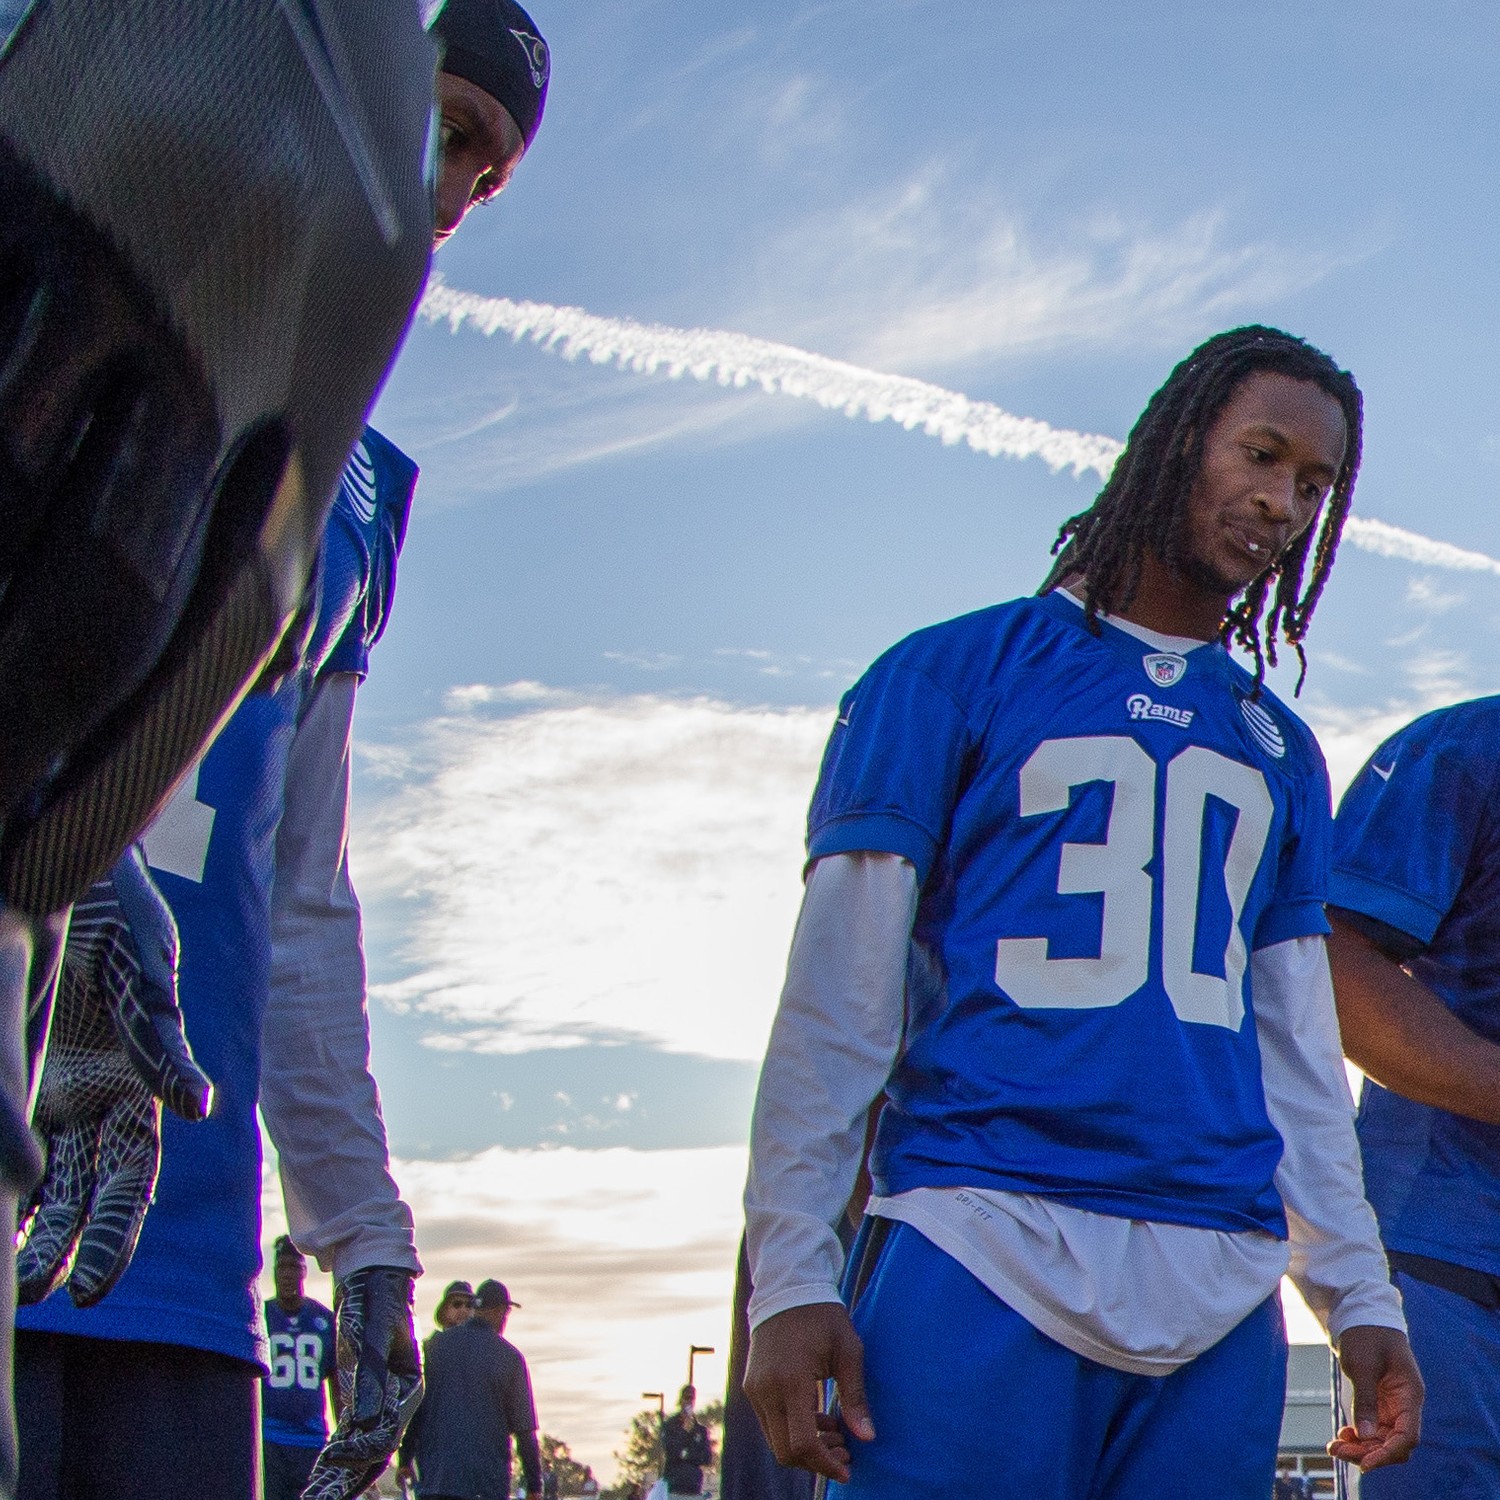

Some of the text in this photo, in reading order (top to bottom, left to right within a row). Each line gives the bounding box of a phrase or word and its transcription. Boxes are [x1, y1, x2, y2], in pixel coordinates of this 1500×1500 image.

[1127, 694, 1194, 728] Rams
[995, 736, 1274, 1033] 30
[270, 1333, 323, 1391] 68
